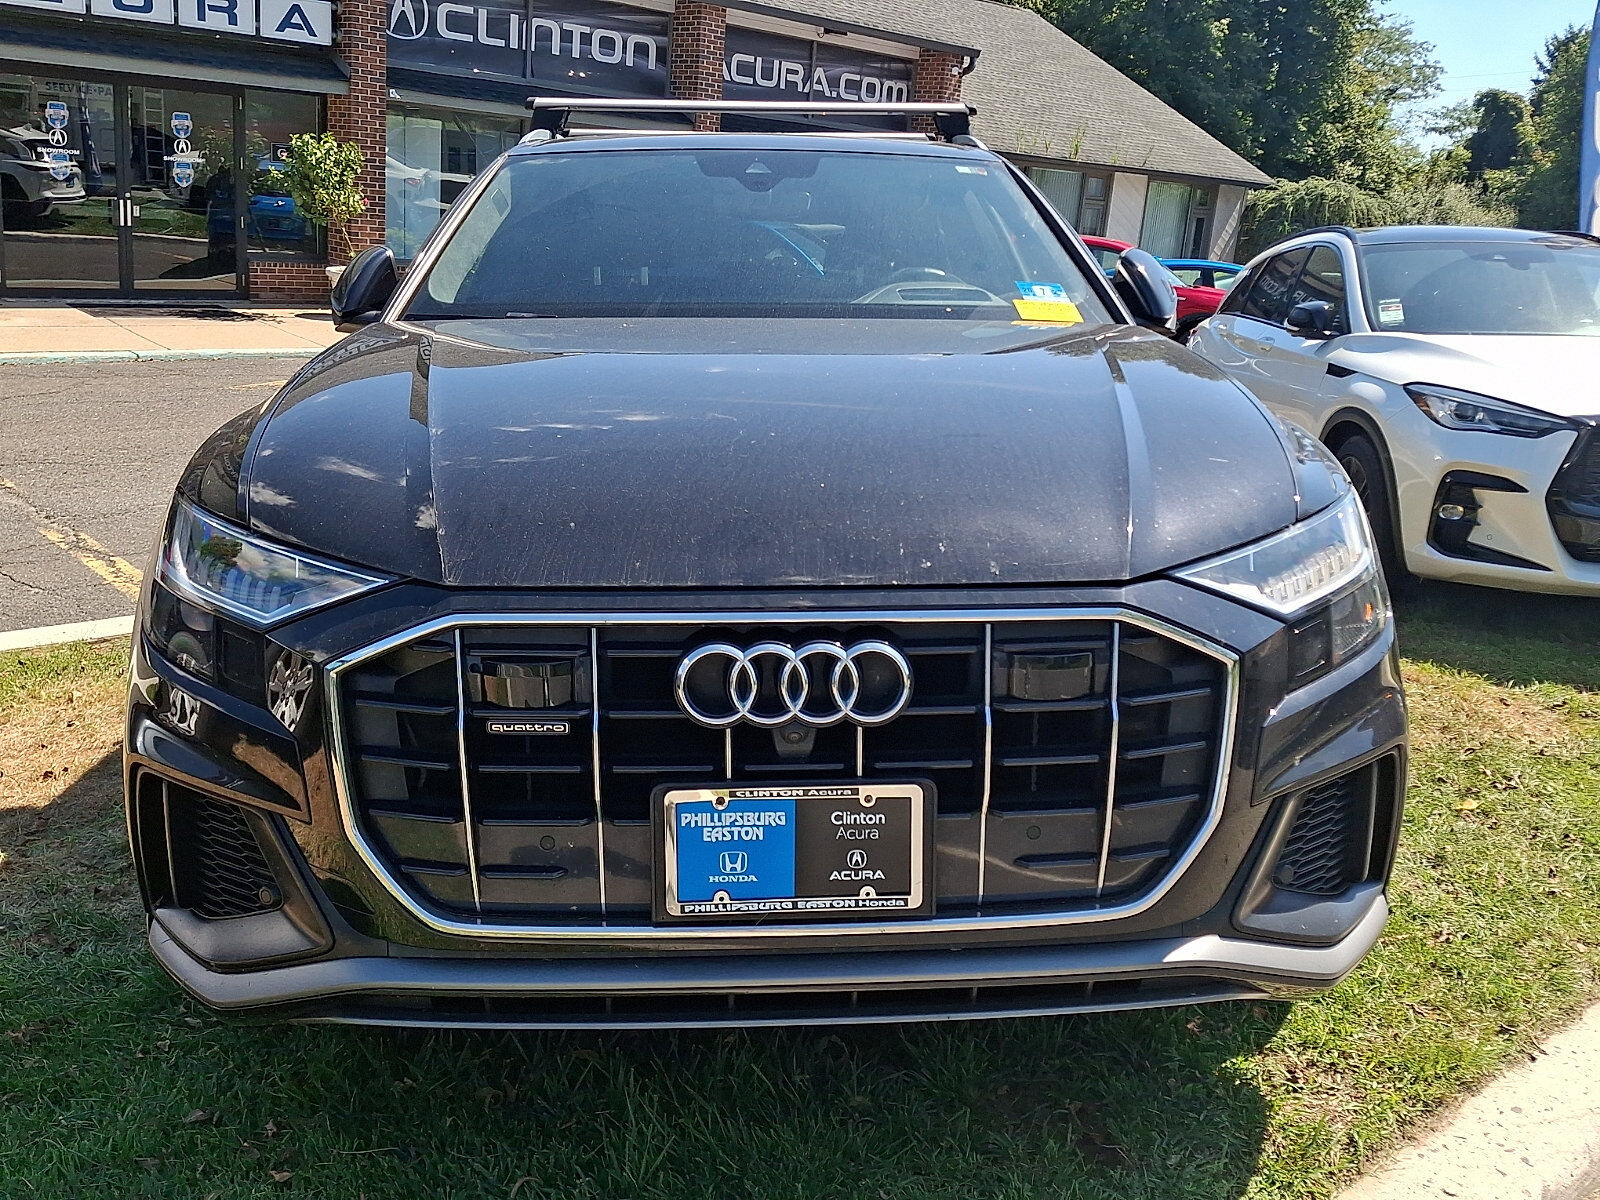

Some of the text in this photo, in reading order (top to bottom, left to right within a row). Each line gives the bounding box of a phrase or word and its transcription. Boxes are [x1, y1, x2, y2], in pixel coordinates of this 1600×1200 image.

[437, 3, 656, 69] CLINTON
[37, 146, 80, 155] SHOWROOM
[163, 155, 204, 163] SHOWROOM
[491, 723, 565, 733] quattro
[735, 788, 852, 797] CLINTON Acura
[680, 811, 786, 828] PHILLIPSBURG
[830, 811, 886, 825] Clinton
[702, 827, 764, 842] EASTON
[835, 826, 880, 840] Acura
[709, 875, 758, 883] HONDA
[829, 870, 886, 881] ACURA
[684, 898, 905, 913] PHILLIPSBURG EASTON Honda
